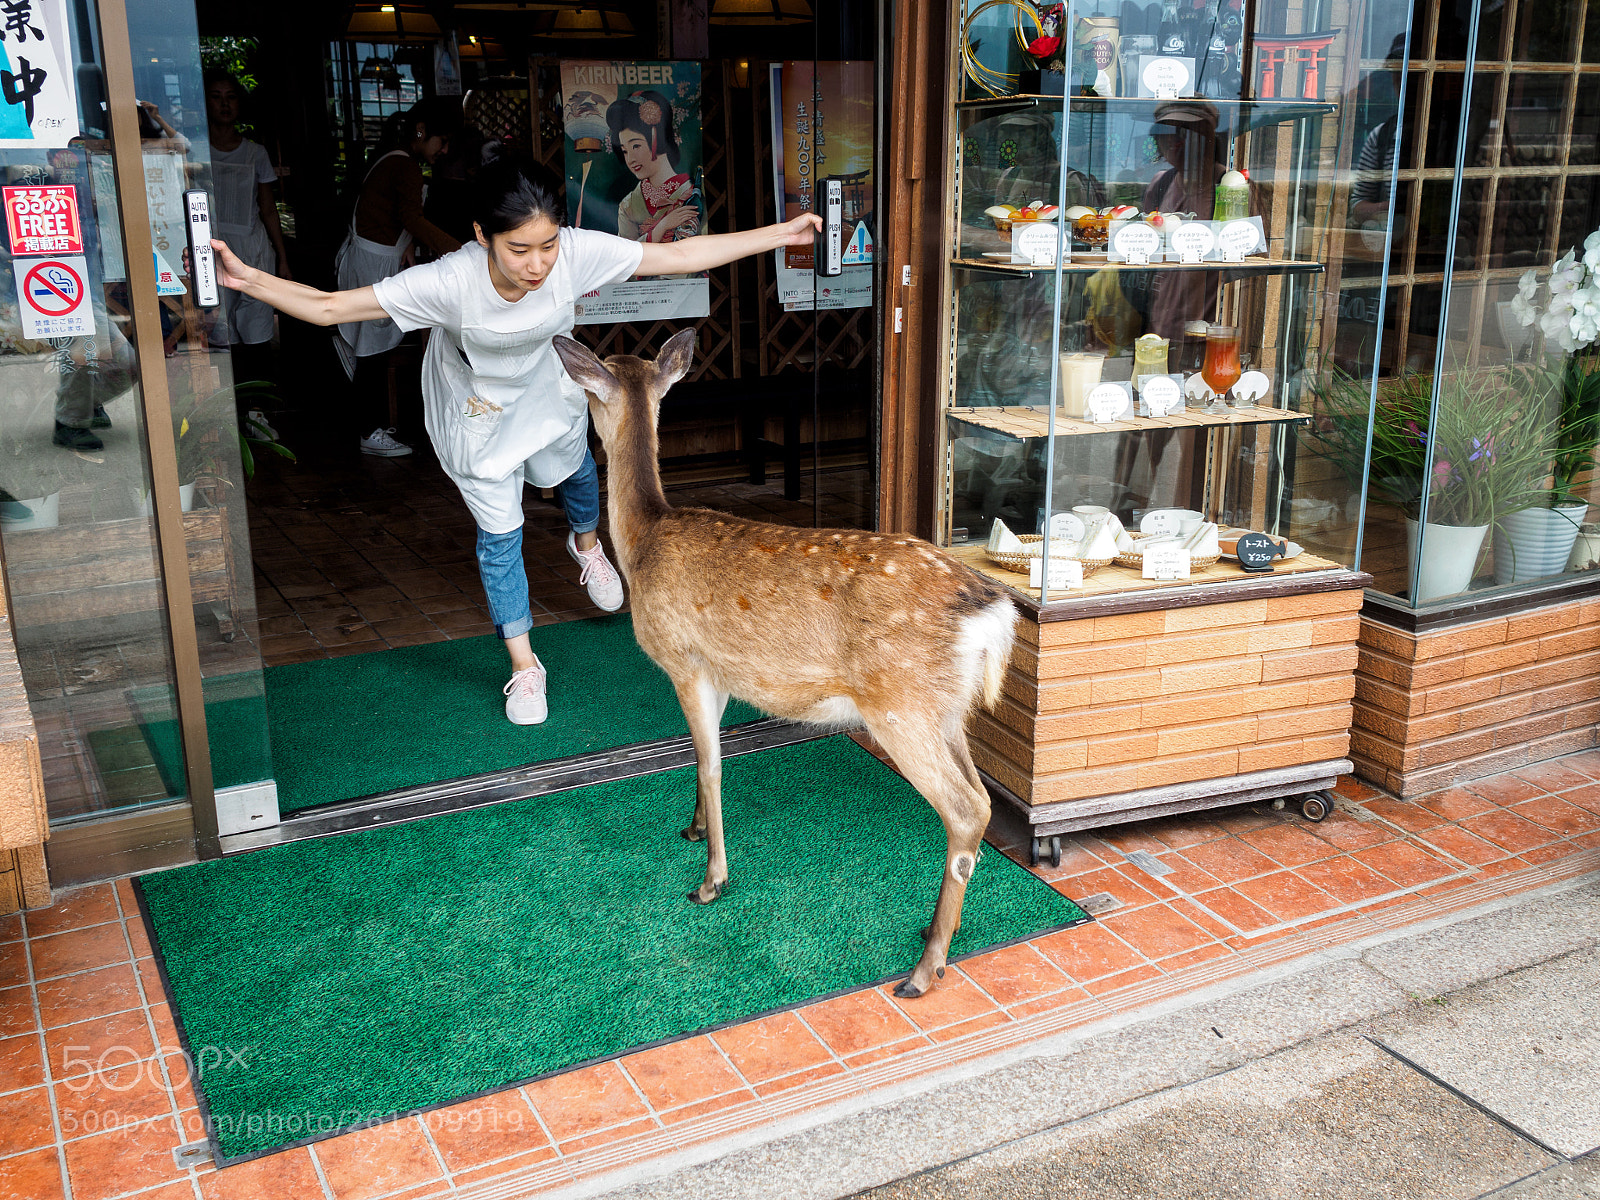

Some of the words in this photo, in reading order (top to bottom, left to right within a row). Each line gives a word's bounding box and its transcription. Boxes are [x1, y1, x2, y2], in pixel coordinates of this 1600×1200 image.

[574, 66, 624, 85] KIRIN
[625, 66, 674, 84] BEER
[38, 118, 66, 128] OPEN
[830, 187, 840, 196] AUTO
[14, 189, 68, 215] るるぶ
[191, 202, 207, 211] AUTO
[146, 166, 170, 251] 空いている
[192, 214, 208, 223] 自動
[19, 213, 69, 237] FREE
[829, 223, 840, 232] PUSH
[24, 236, 69, 252] 掲載店
[195, 245, 212, 254] PUSH
[160, 271, 173, 283] 意
[34, 317, 82, 327] 禁煙にご協力
[37, 325, 85, 335] お願いします。
[1245, 539, 1270, 548] トースト
[1248, 552, 1271, 562] ¥250
